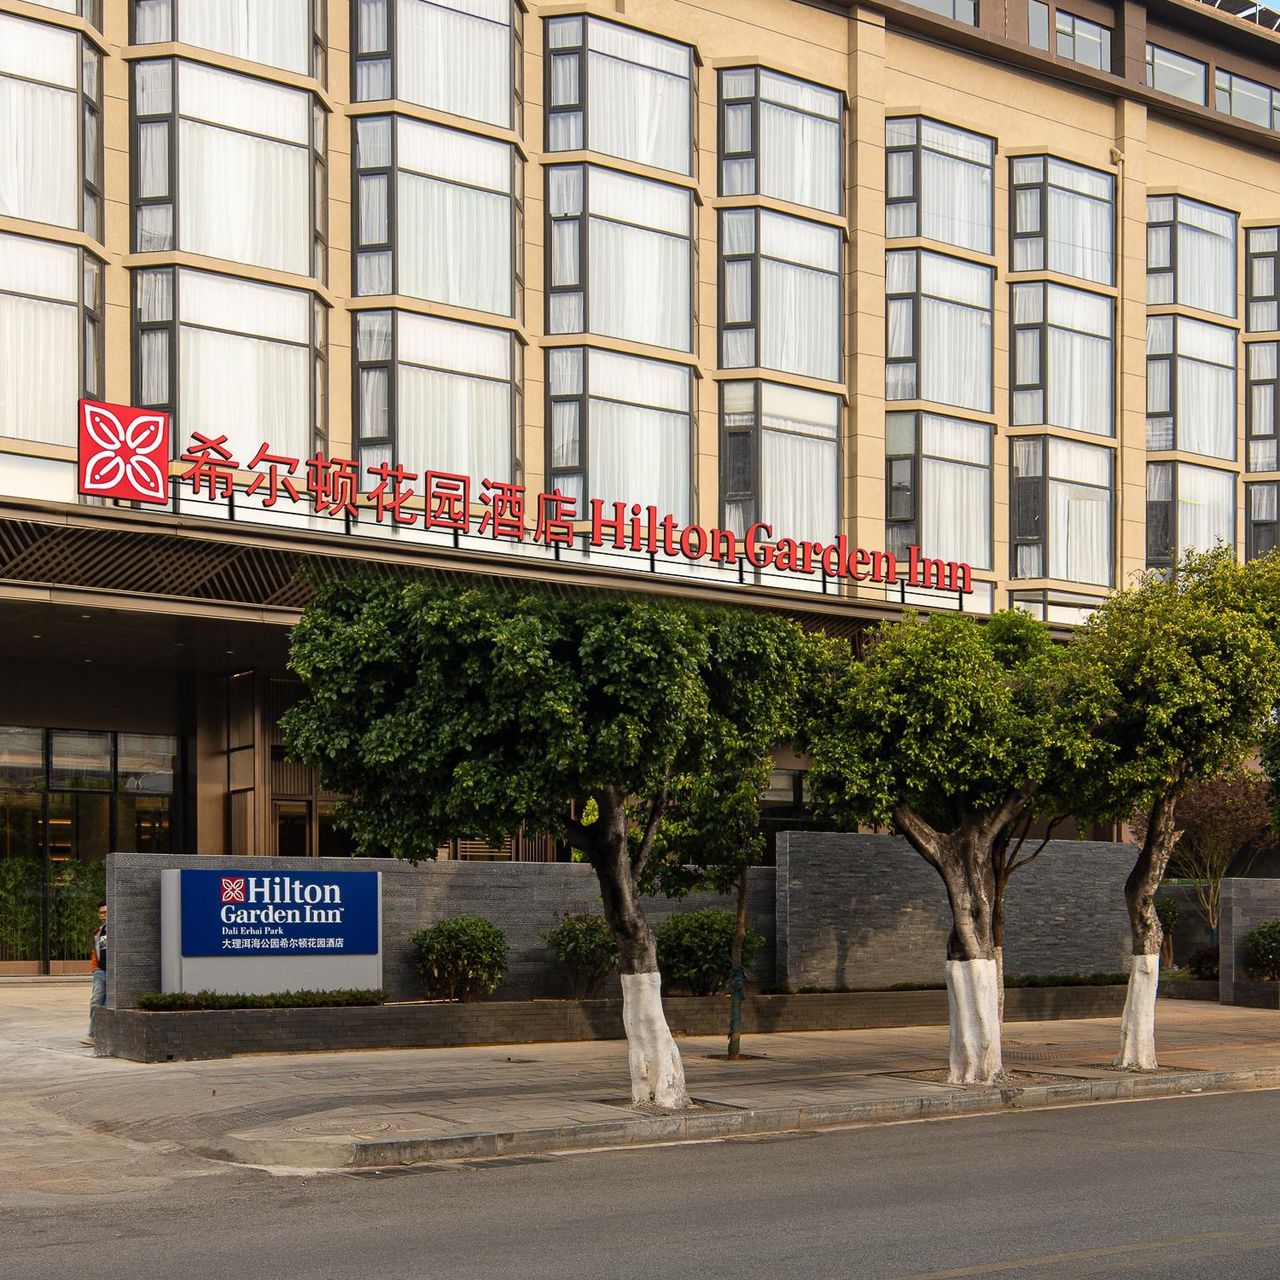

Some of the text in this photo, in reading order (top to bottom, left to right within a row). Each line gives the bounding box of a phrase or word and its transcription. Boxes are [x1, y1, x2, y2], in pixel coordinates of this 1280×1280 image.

[180, 431, 974, 594] 希尔顿花园酒店 Hilton Garden Inn
[247, 876, 342, 904] Hilton
[220, 904, 302, 924] Garden
[221, 926, 284, 935] Dali Erhai Park
